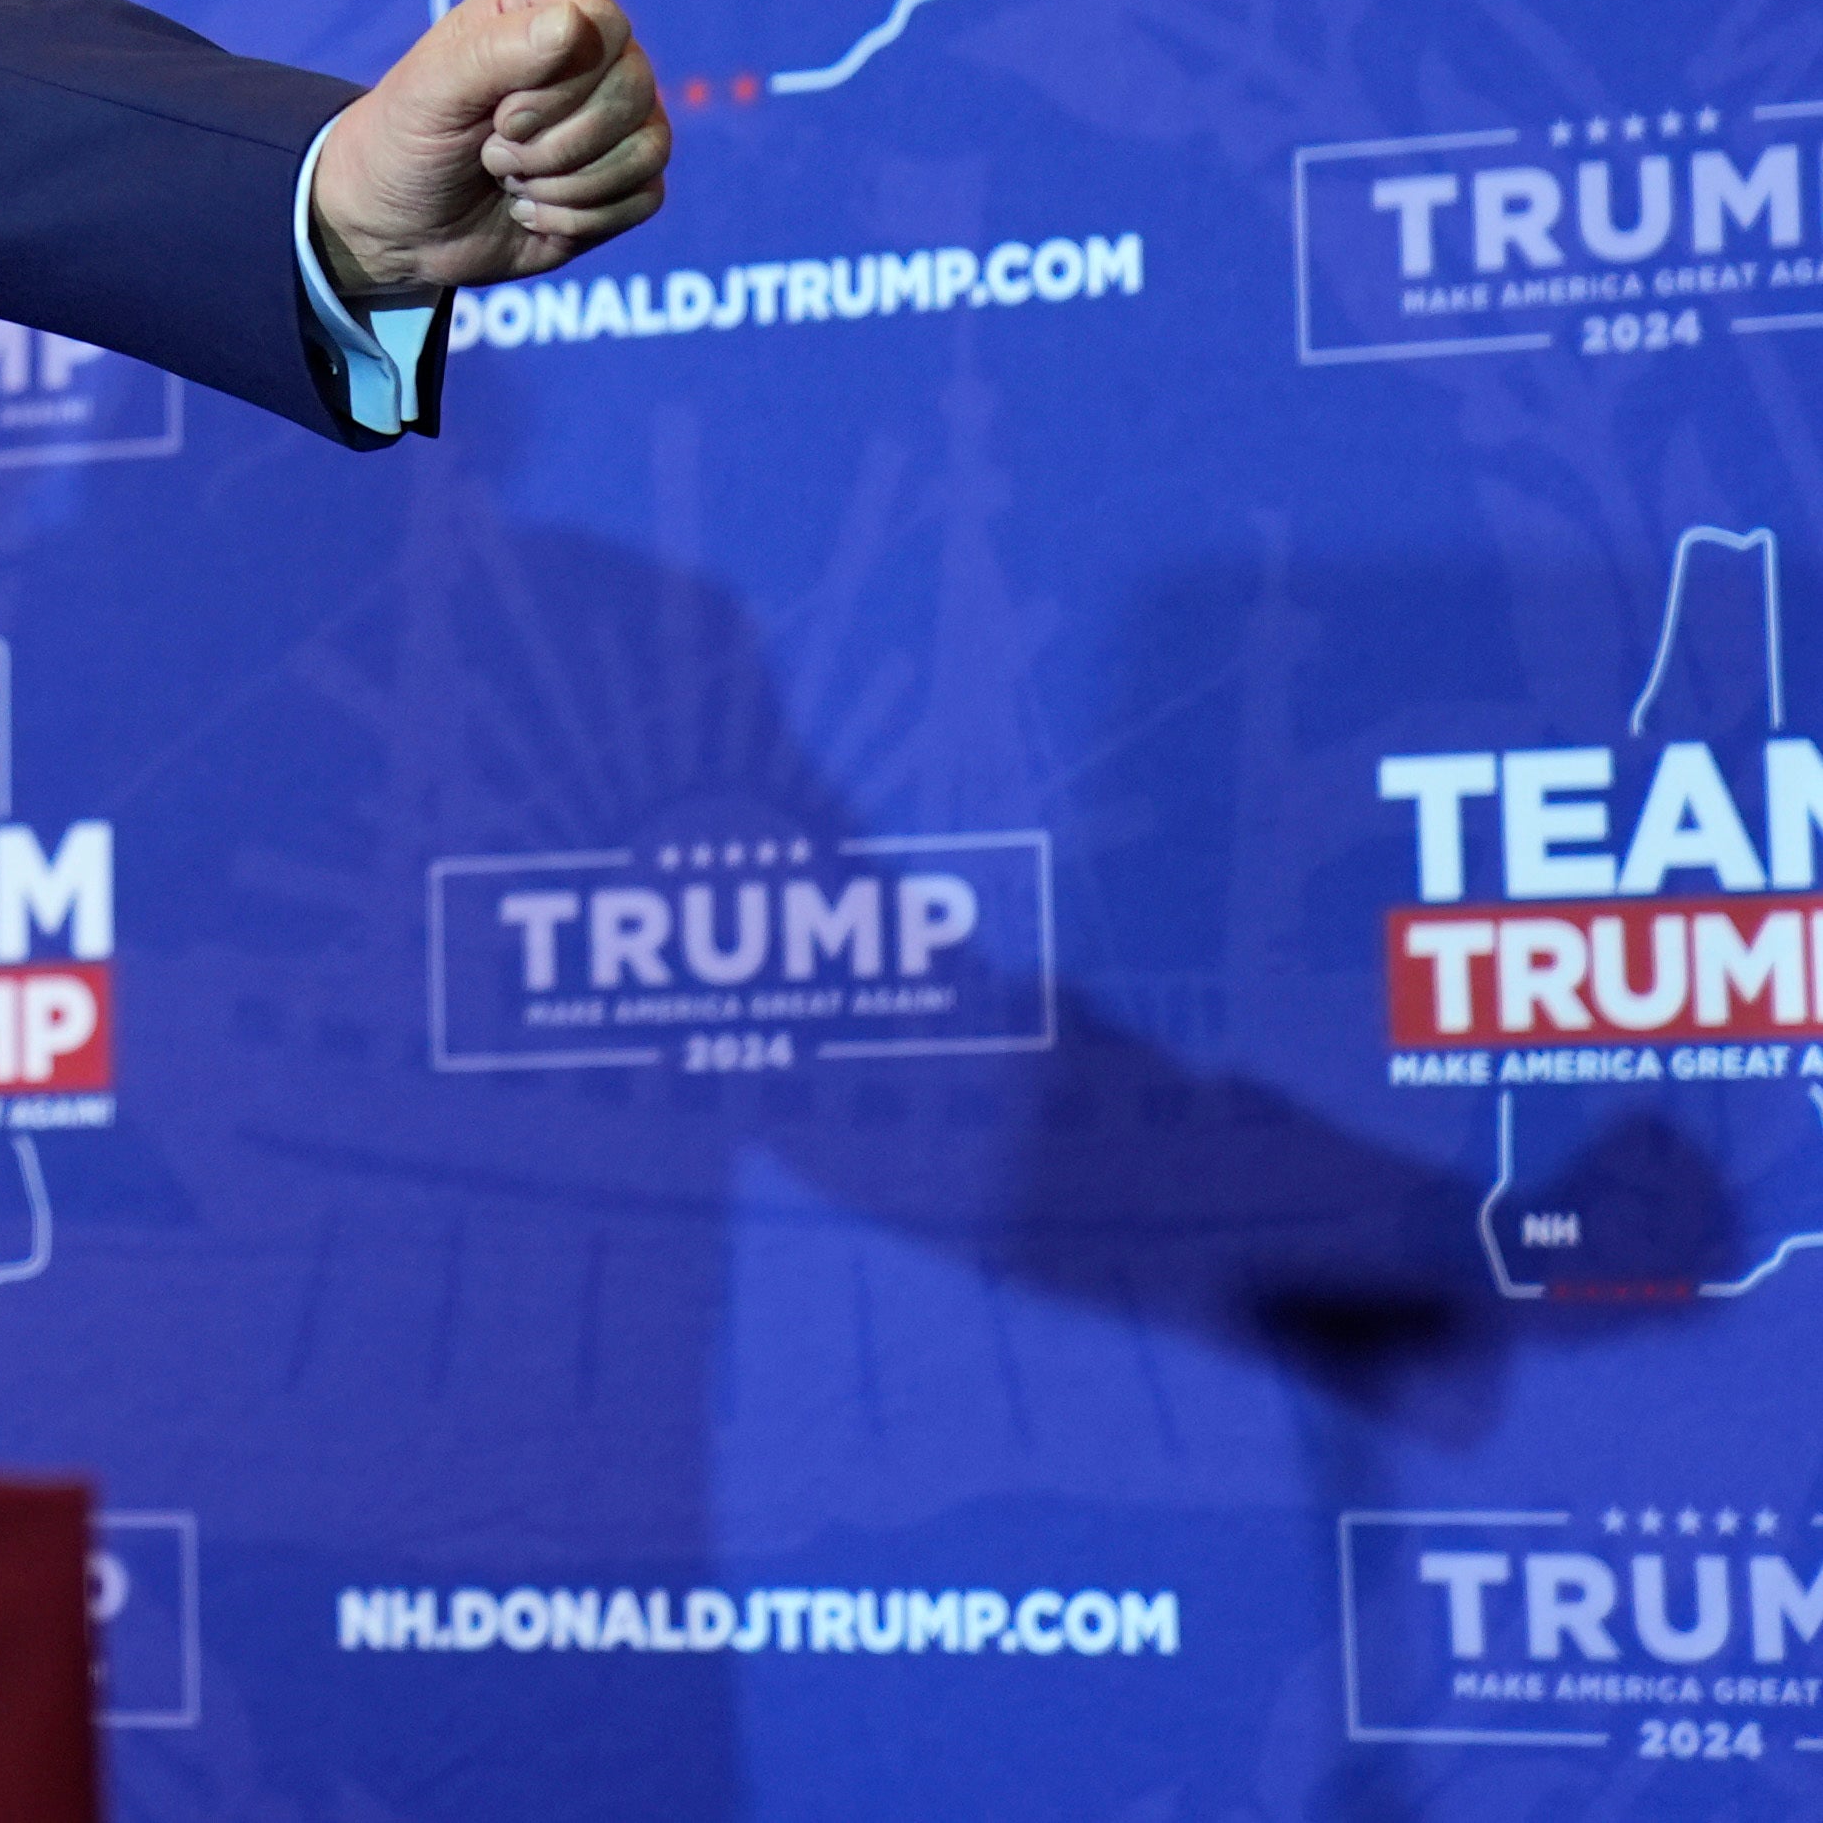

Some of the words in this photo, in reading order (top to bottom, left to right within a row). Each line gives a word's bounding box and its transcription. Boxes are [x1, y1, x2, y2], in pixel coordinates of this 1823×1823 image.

[1372, 143, 1823, 278] TRUM
[447, 231, 1143, 354] DONALDJTRUMP.COM
[1402, 285, 1489, 317] MAKE
[1500, 274, 1643, 309] AMERICA
[1655, 261, 1759, 297] GREAT
[1580, 309, 1702, 356] 2024
[497, 873, 979, 993] TRUMP
[1404, 910, 1823, 1035] TRUM
[684, 1030, 795, 1074] 2024
[1389, 1049, 1492, 1086] MAKE
[1499, 1047, 1663, 1084] AMERICA
[1670, 1044, 1791, 1081] GREAT
[1521, 1211, 1581, 1248] NH
[337, 1587, 1181, 1655] NH.DONALDJTRUMP.COM
[1418, 1552, 1823, 1665] TRUM
[1453, 1671, 1547, 1701] MAKE
[1556, 1673, 1703, 1705] AMERICA
[1712, 1675, 1823, 1707] GREAT
[1637, 1718, 1765, 1761] 2024
